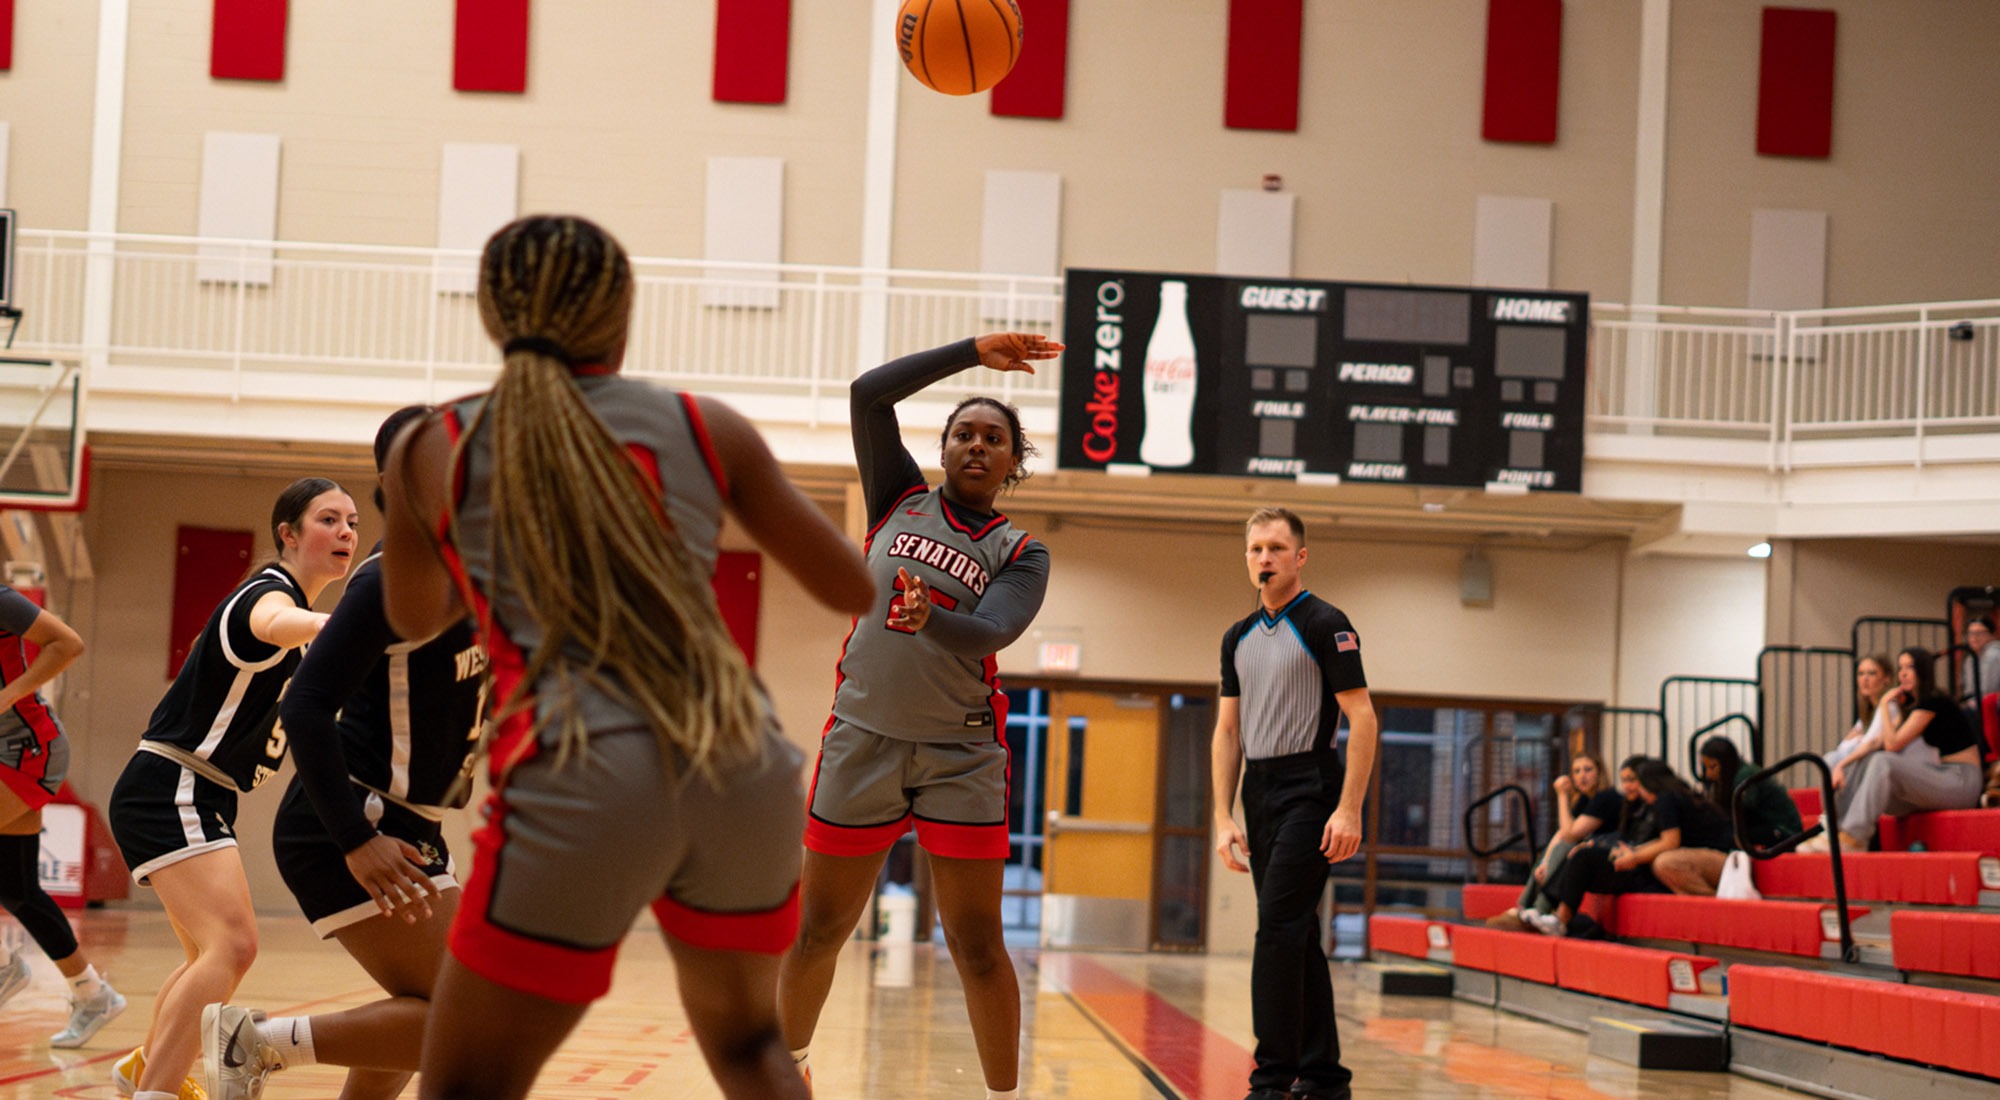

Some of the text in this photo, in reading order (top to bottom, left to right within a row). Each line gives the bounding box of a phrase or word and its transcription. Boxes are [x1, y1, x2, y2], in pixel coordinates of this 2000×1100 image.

[1241, 286, 1325, 310] GUEST
[1495, 299, 1568, 322] HOME
[1082, 280, 1124, 463] Coke zero
[1339, 363, 1414, 383] PERIOD
[1252, 401, 1305, 418] FOULS
[1349, 405, 1458, 425] PLAYER-FOUL
[1502, 413, 1554, 430] FOULS
[1247, 458, 1306, 474] POINTS
[1348, 464, 1407, 479] MATCH
[1498, 470, 1555, 486] POINTS
[888, 532, 990, 598] SENATORS
